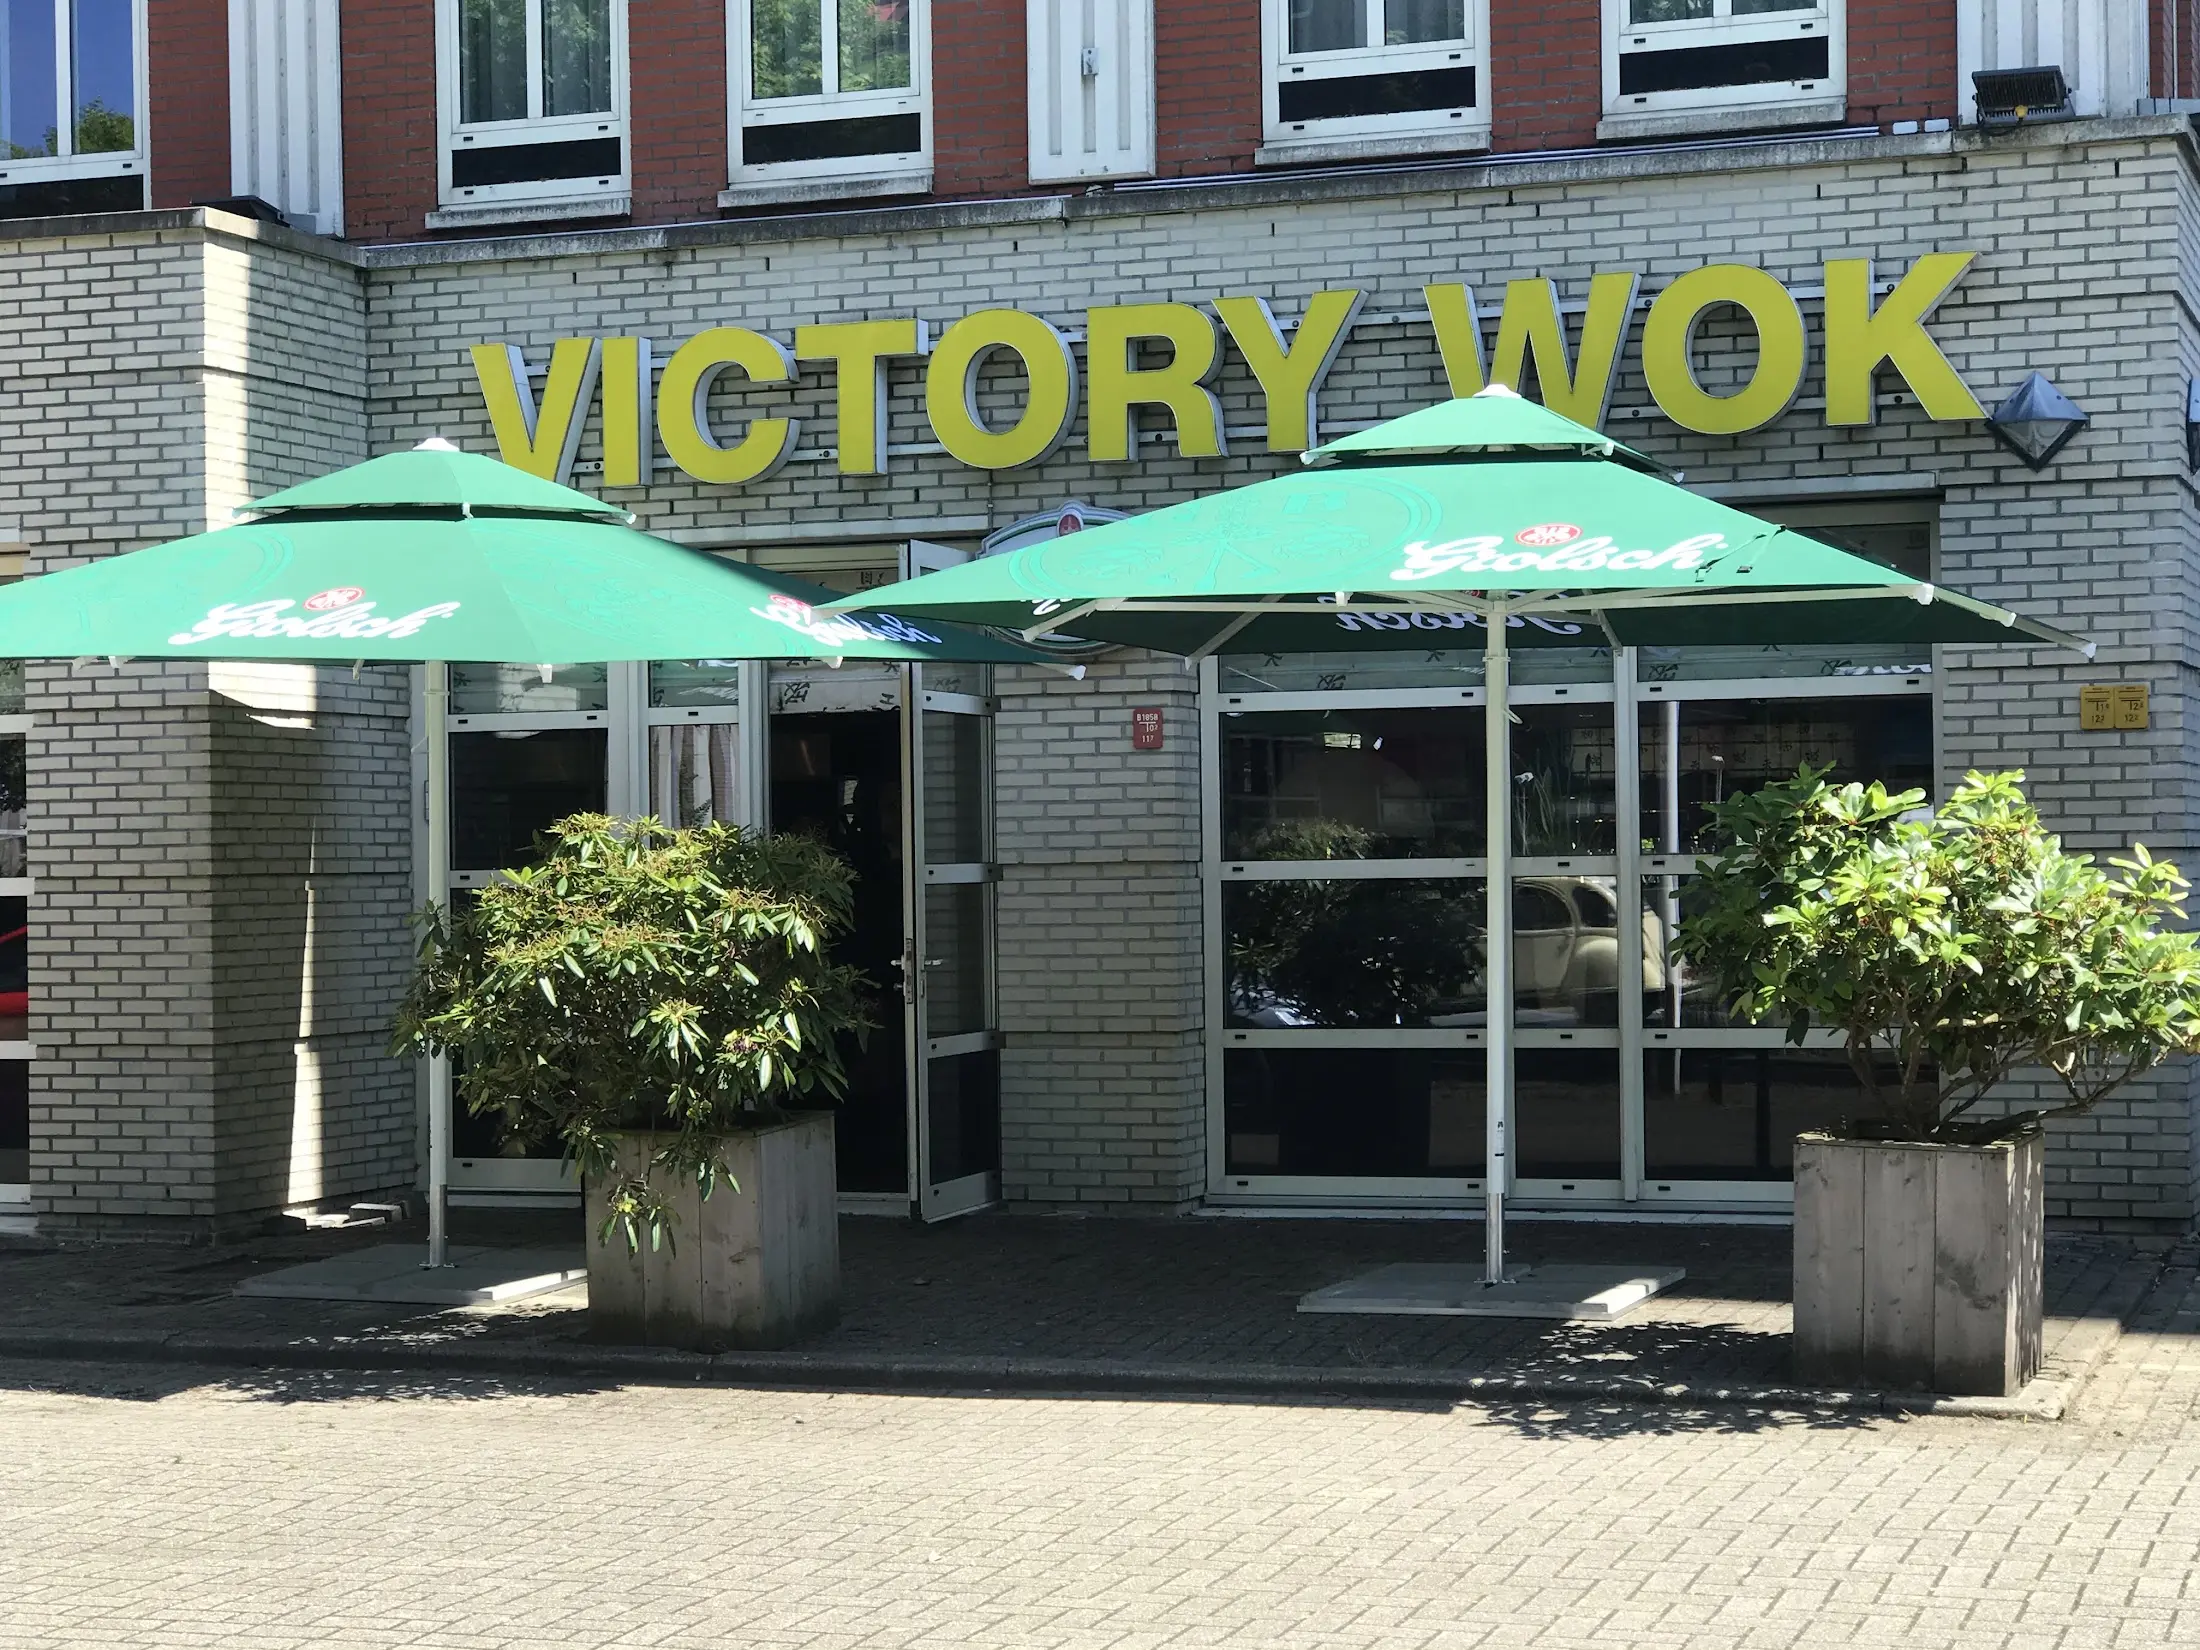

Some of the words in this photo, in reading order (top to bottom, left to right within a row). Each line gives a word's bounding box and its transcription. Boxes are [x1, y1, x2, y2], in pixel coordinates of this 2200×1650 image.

[470, 289, 1369, 487] VICTORY
[1423, 251, 1992, 435] WOK
[1389, 532, 1729, 582] Grolsch
[167, 598, 462, 645] Grolsch
[1136, 713, 1158, 721] B1858
